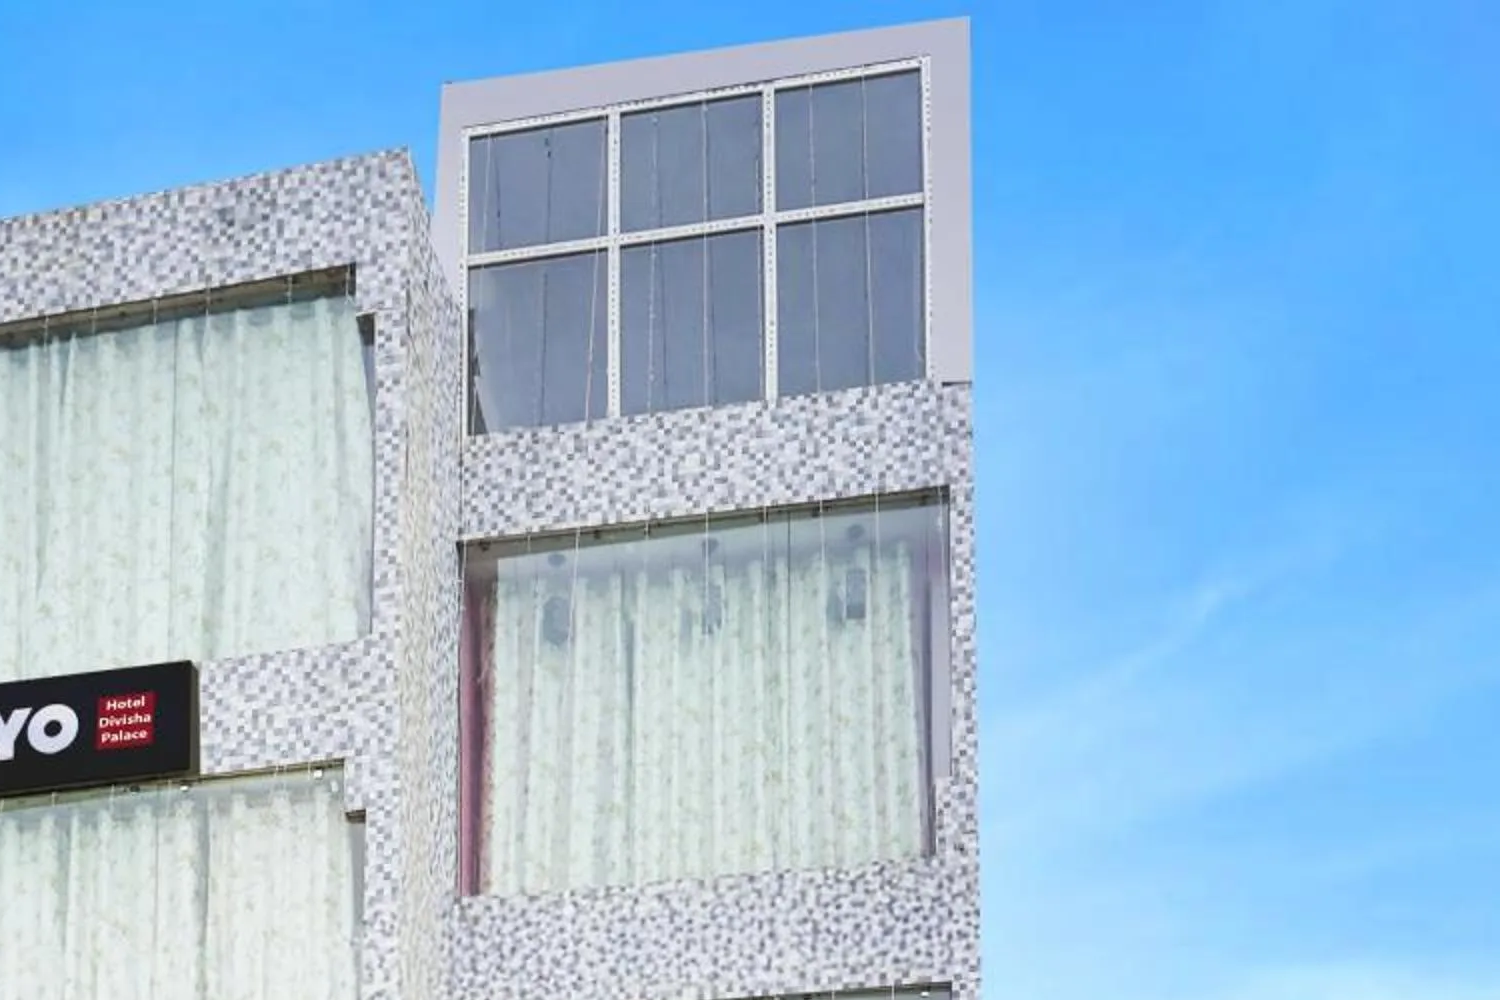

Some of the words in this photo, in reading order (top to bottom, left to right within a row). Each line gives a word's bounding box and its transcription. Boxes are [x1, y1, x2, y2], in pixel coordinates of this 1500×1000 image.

[105, 695, 145, 710] Hotel
[99, 712, 151, 728] Divisha
[101, 729, 148, 743] Palace
